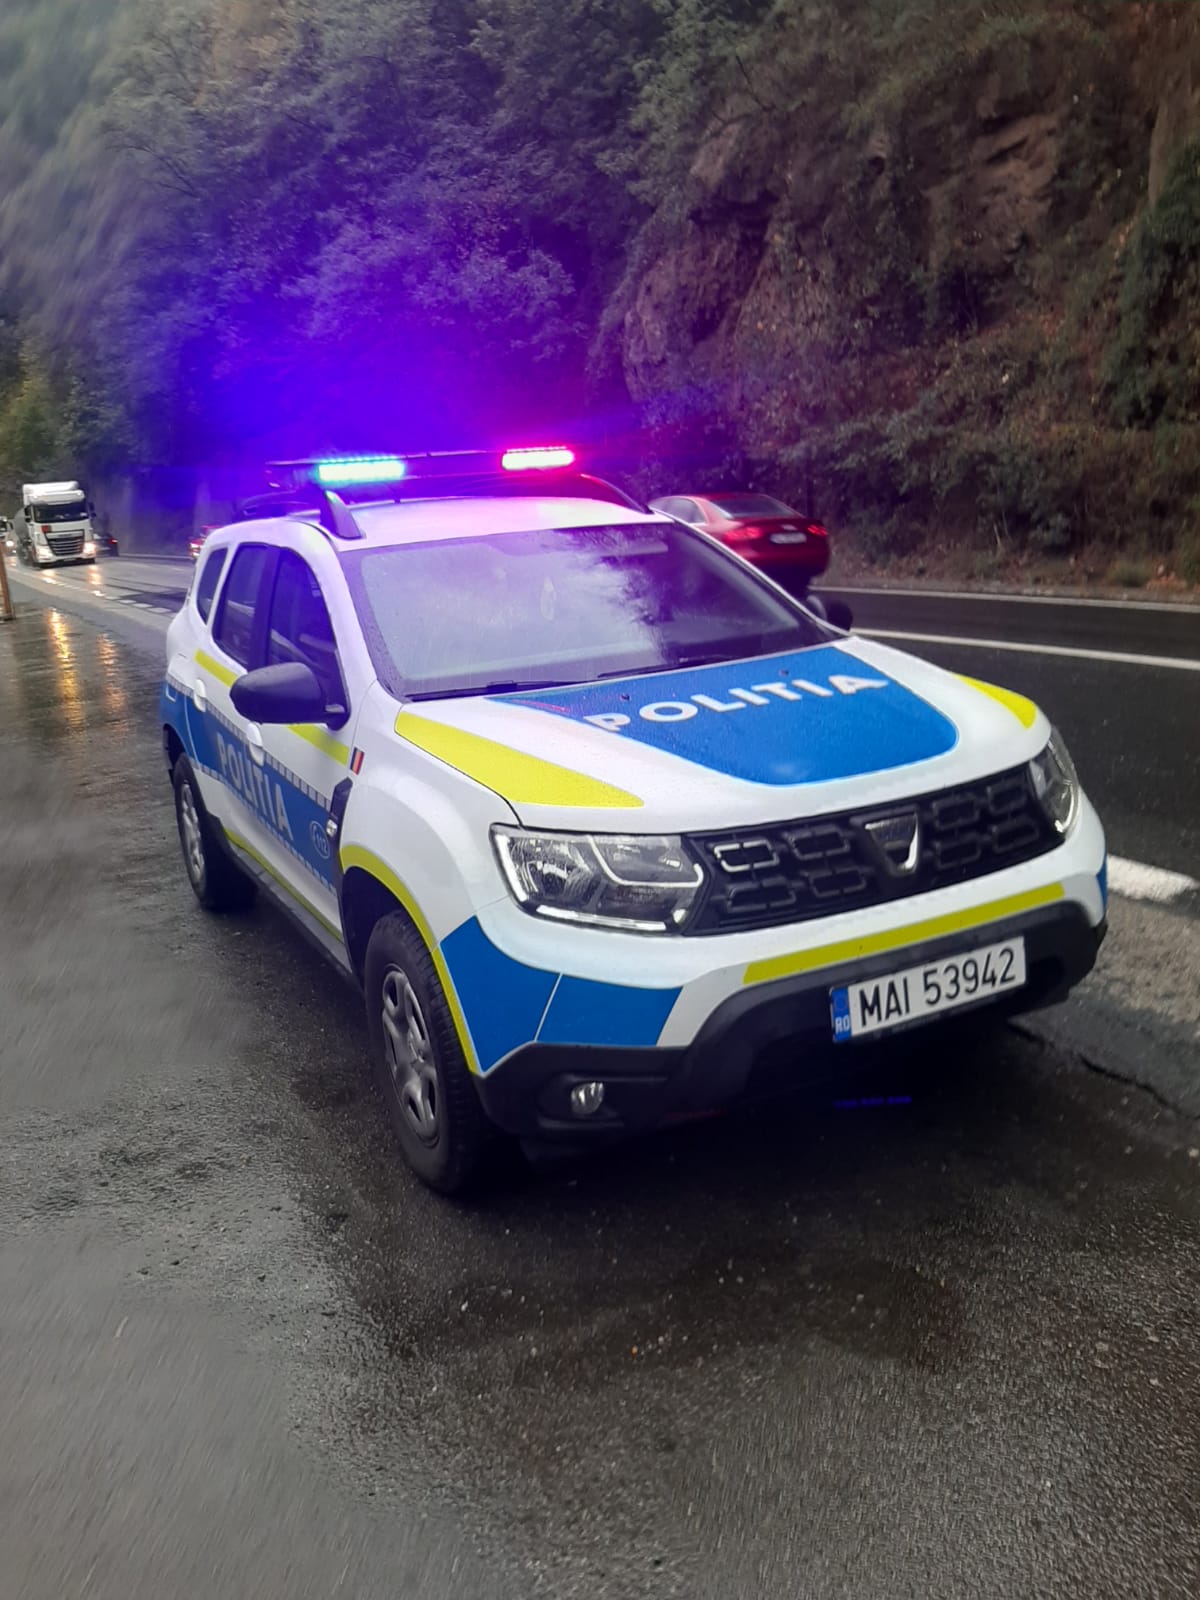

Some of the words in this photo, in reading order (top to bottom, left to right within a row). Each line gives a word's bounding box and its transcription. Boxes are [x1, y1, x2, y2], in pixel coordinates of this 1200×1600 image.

[859, 976, 910, 1027] MAI
[923, 948, 1015, 1006] 53942
[835, 1015, 850, 1034] RO
